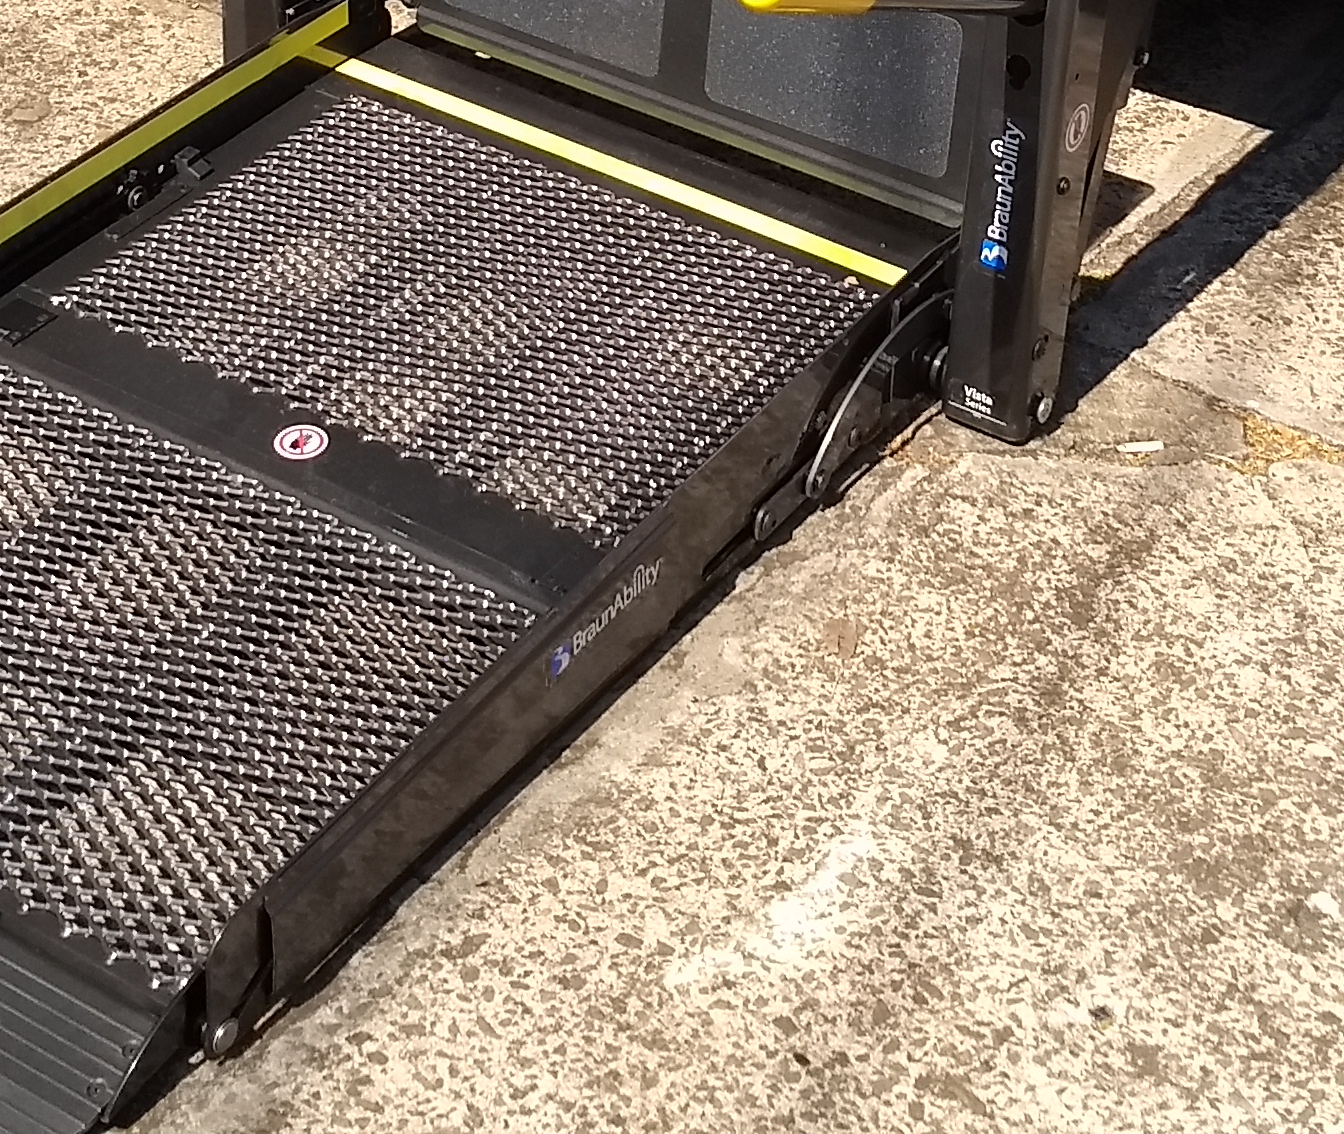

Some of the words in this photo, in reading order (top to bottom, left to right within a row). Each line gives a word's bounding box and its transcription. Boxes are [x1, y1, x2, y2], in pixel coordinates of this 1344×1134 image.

[987, 120, 1027, 242] BraunAbility
[963, 384, 994, 406] Vista
[964, 397, 992, 415] Series
[572, 557, 662, 656] BraunAbility
